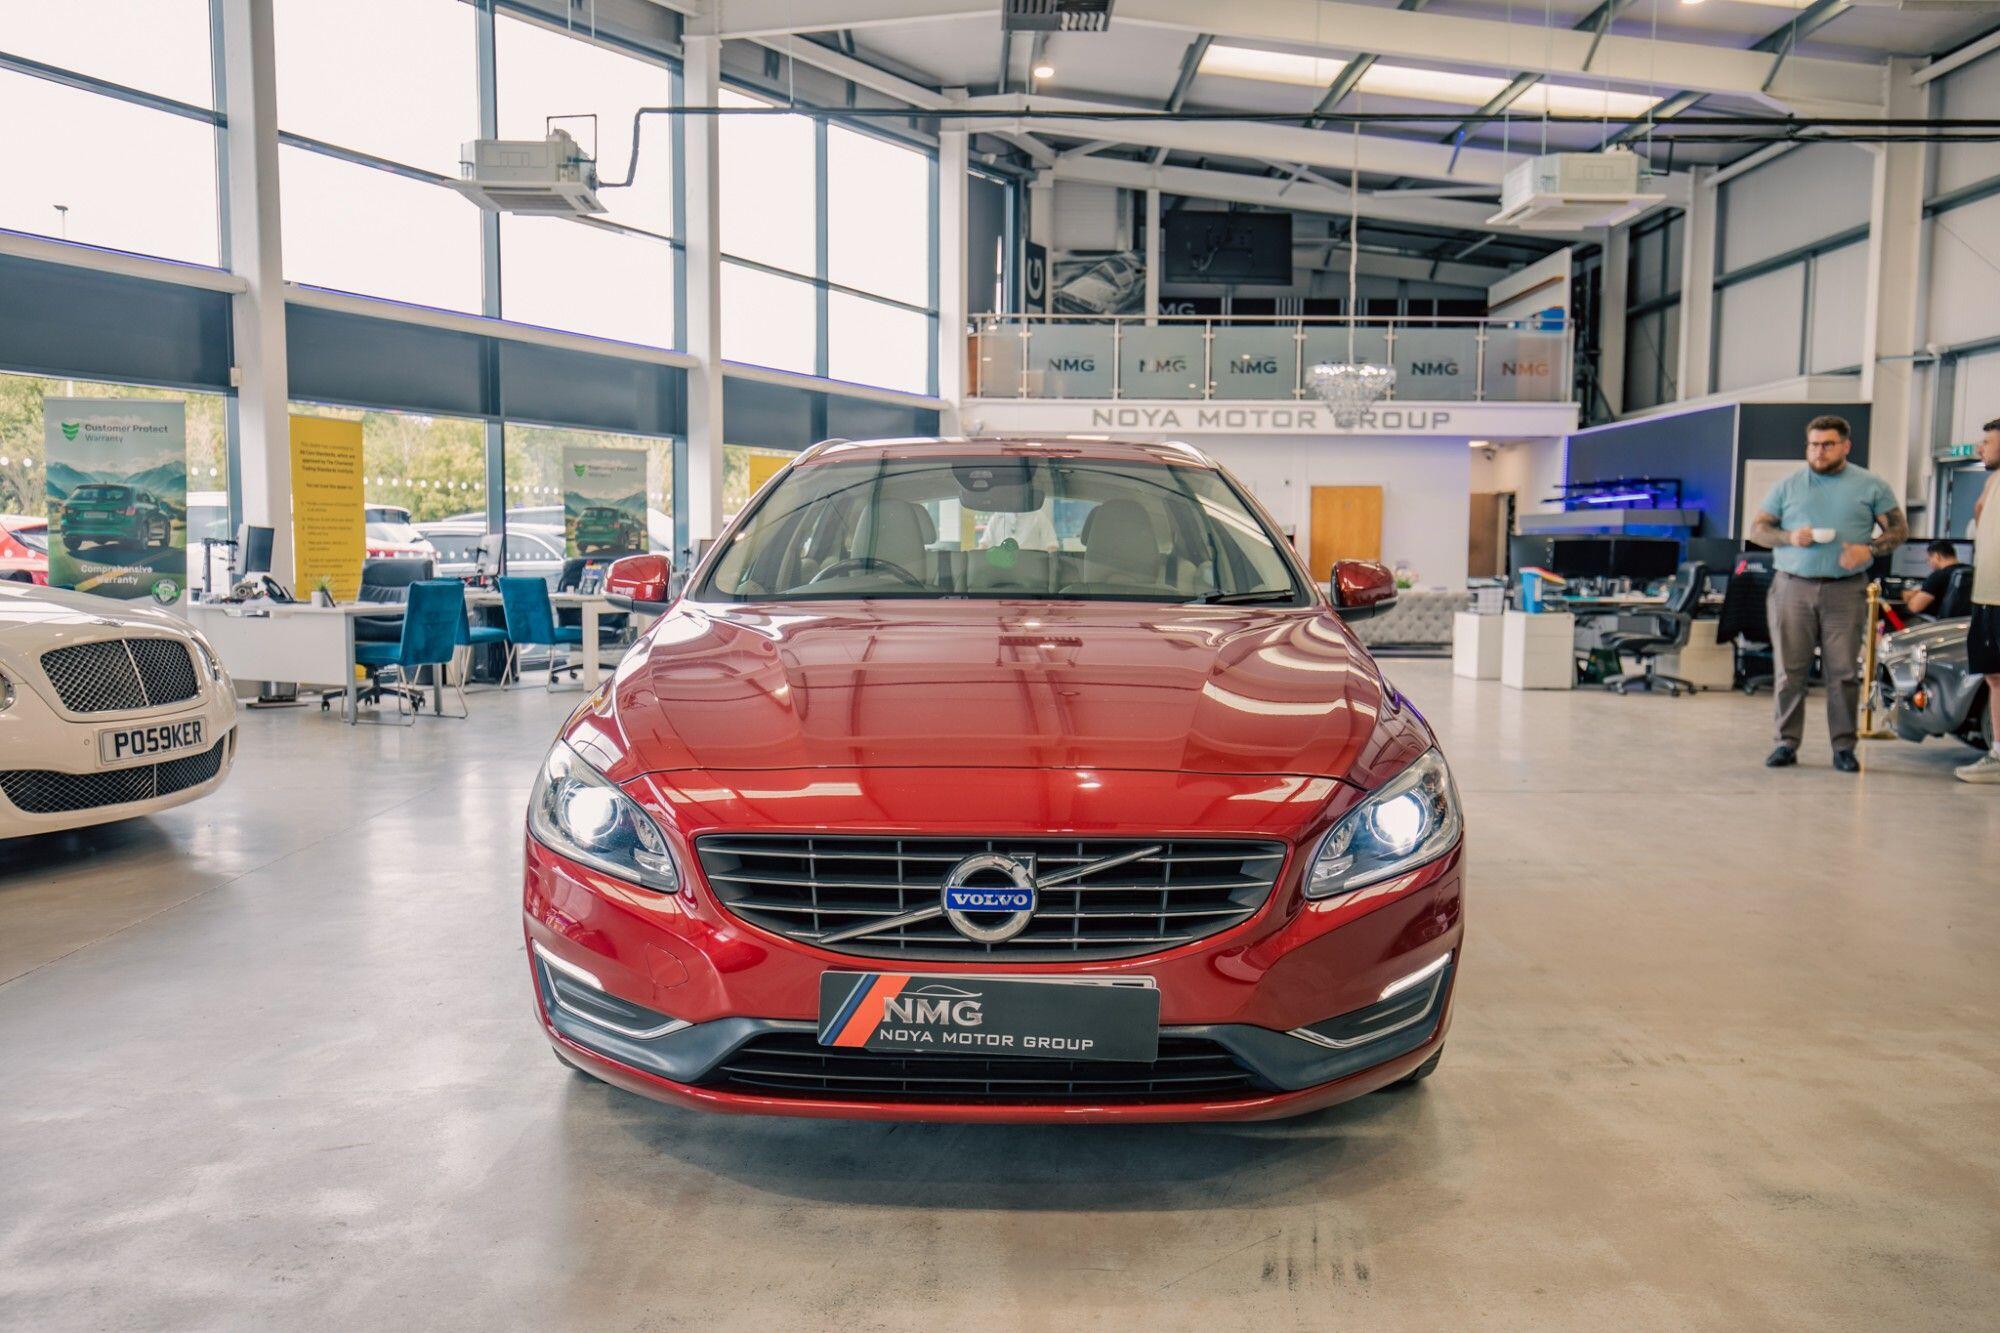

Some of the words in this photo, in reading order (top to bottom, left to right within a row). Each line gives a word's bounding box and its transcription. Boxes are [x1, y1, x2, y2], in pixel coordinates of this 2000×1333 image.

[1048, 358, 1095, 372] NMG
[1230, 360, 1277, 374] NMG
[1411, 362, 1458, 376] NMG
[1502, 362, 1549, 376] NMG
[1092, 409, 1181, 427] NOYA
[1198, 410, 1317, 429] MOTOR
[84, 423, 130, 433] Customer
[132, 424, 168, 433] Protect
[85, 434, 124, 443] Warranty
[80, 564, 154, 576] Comprehensive
[97, 575, 139, 586] Warranty
[952, 893, 1028, 906] VOLVO
[883, 996, 983, 1027] NMG
[879, 1028, 934, 1043] NOYA
[942, 1033, 1014, 1047] MOTOR
[1023, 1036, 1094, 1051] GROUP
